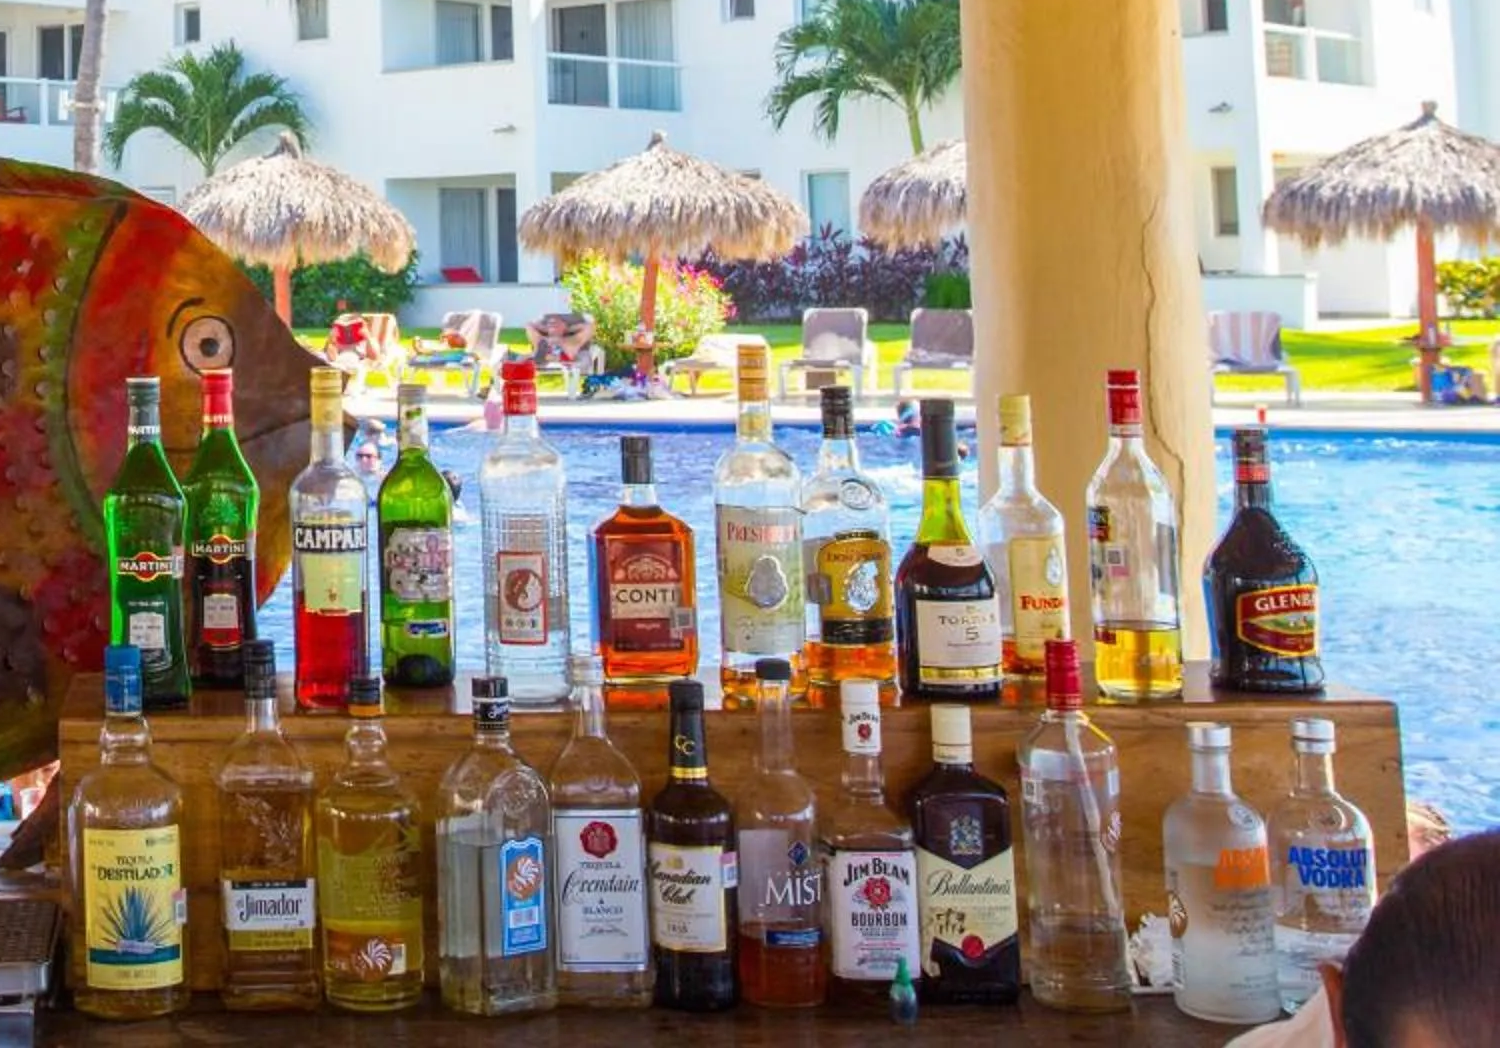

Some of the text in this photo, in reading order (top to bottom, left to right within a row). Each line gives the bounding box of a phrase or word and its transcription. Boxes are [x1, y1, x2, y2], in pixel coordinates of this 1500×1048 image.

[195, 543, 245, 553] MARTINI
[615, 588, 677, 604] CONTI
[965, 626, 980, 641] 5
[1289, 845, 1367, 868] ABSOLUT
[843, 857, 910, 887] JIM BEAM
[1298, 865, 1365, 888] VODKA
[660, 882, 697, 904] Club
[765, 873, 821, 906] MIST
[239, 892, 302, 922] Jimador
[851, 912, 908, 926] BOURBON
